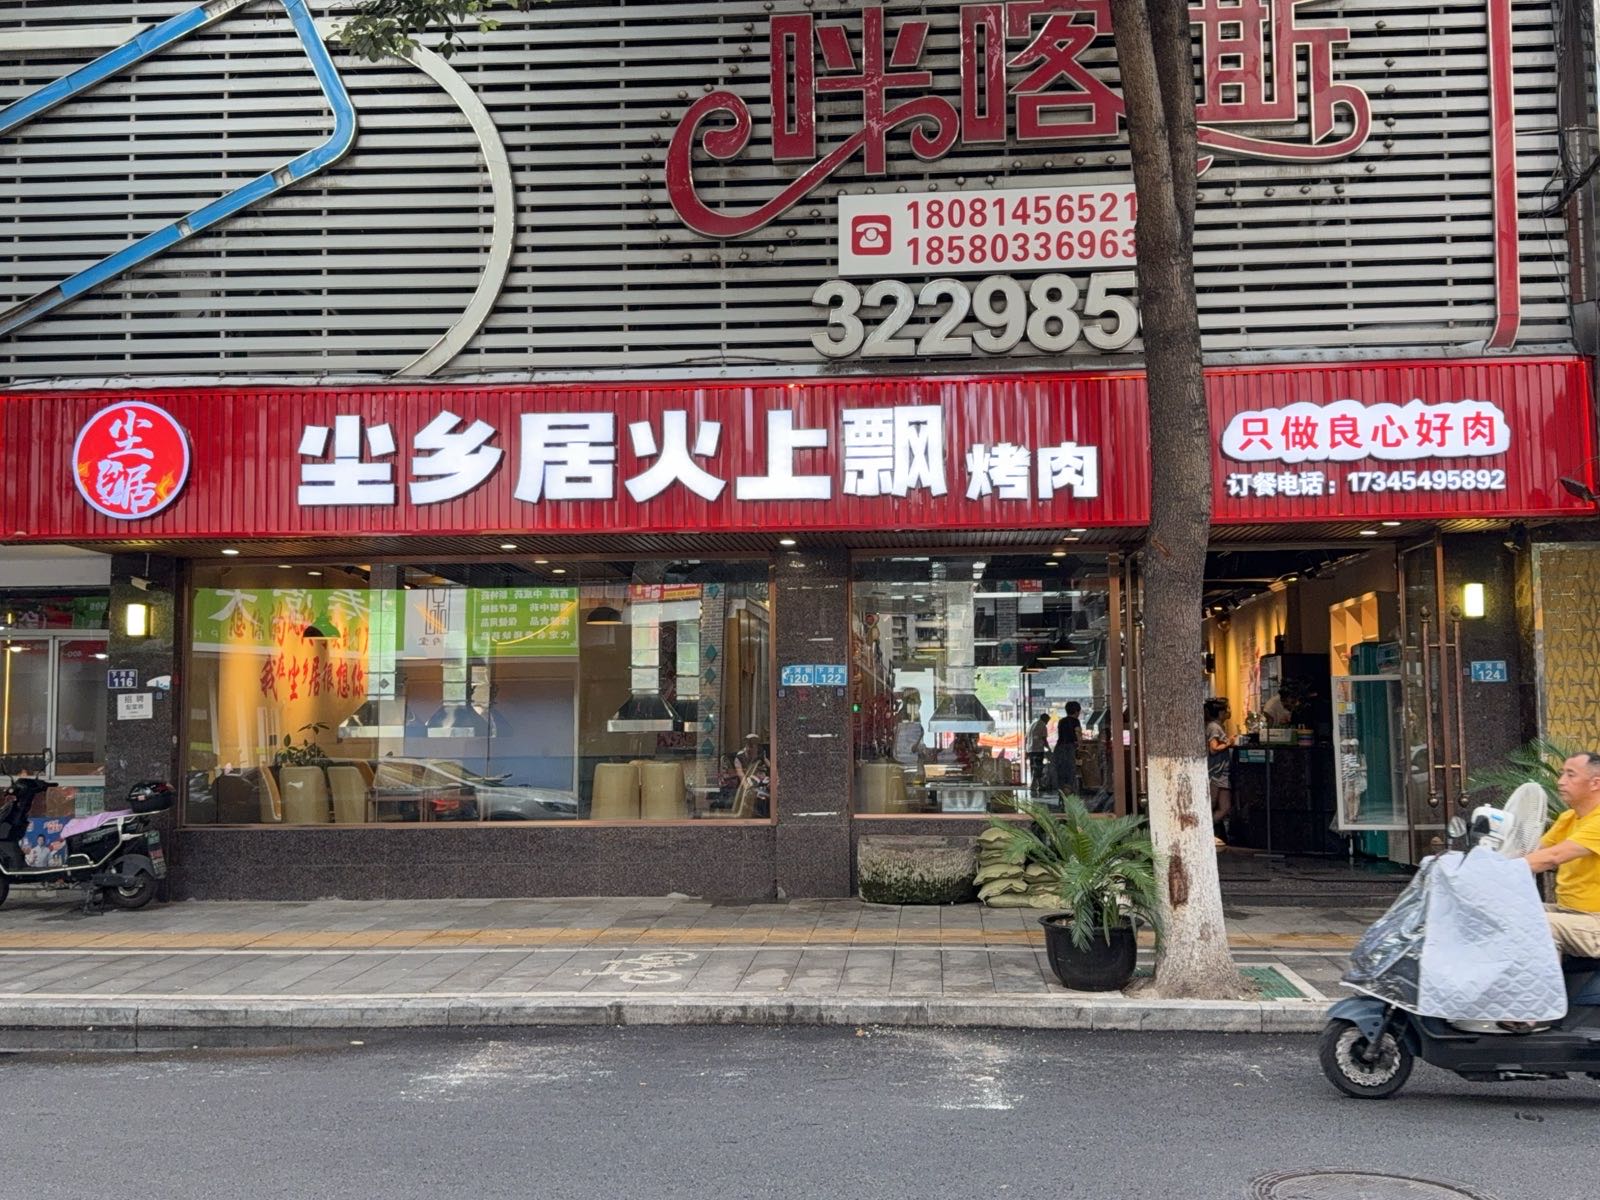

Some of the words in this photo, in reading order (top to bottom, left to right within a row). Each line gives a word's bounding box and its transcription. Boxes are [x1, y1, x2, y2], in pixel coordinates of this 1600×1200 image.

[906, 192, 1137, 230] 18081456521
[906, 228, 1137, 266] 18580336963
[810, 270, 1143, 358] 322985
[1237, 410, 1496, 452] 只做良心好肉
[297, 404, 949, 506] 尘乡居火上飘
[965, 441, 1099, 501] 烤肉
[113, 677, 134, 687] 116
[789, 673, 809, 683] 120
[821, 673, 841, 683] 122
[1478, 670, 1501, 680] 124
